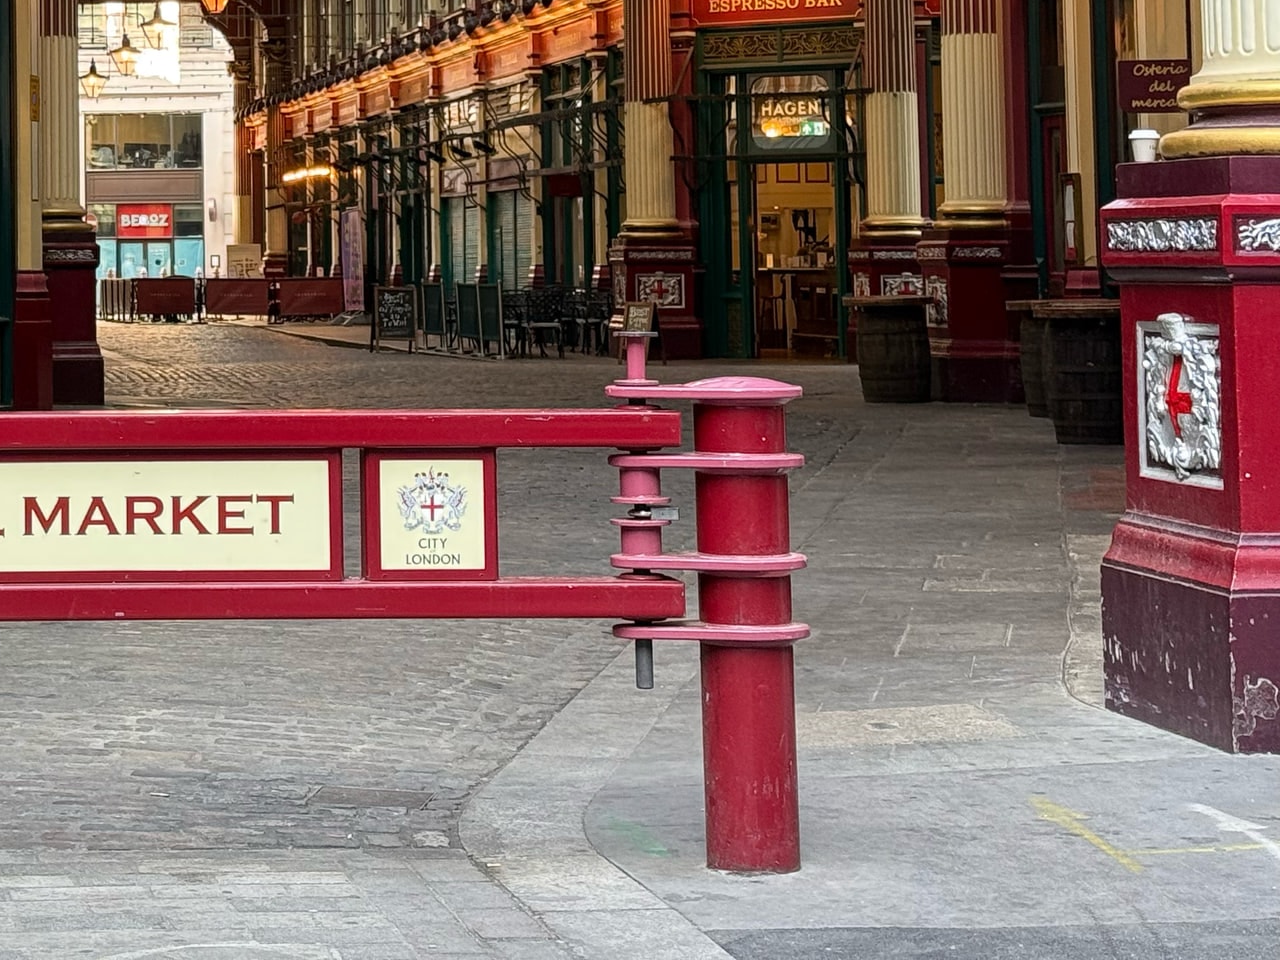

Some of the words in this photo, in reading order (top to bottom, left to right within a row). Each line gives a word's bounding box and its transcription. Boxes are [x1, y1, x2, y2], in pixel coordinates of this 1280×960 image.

[1132, 62, 1189, 76] Osteria
[1148, 79, 1176, 93] del
[761, 100, 820, 117] HAGEN
[1131, 97, 1177, 108] merca
[22, 493, 295, 537] MARKET
[418, 538, 448, 549] CITY
[406, 554, 461, 566] LONDON
